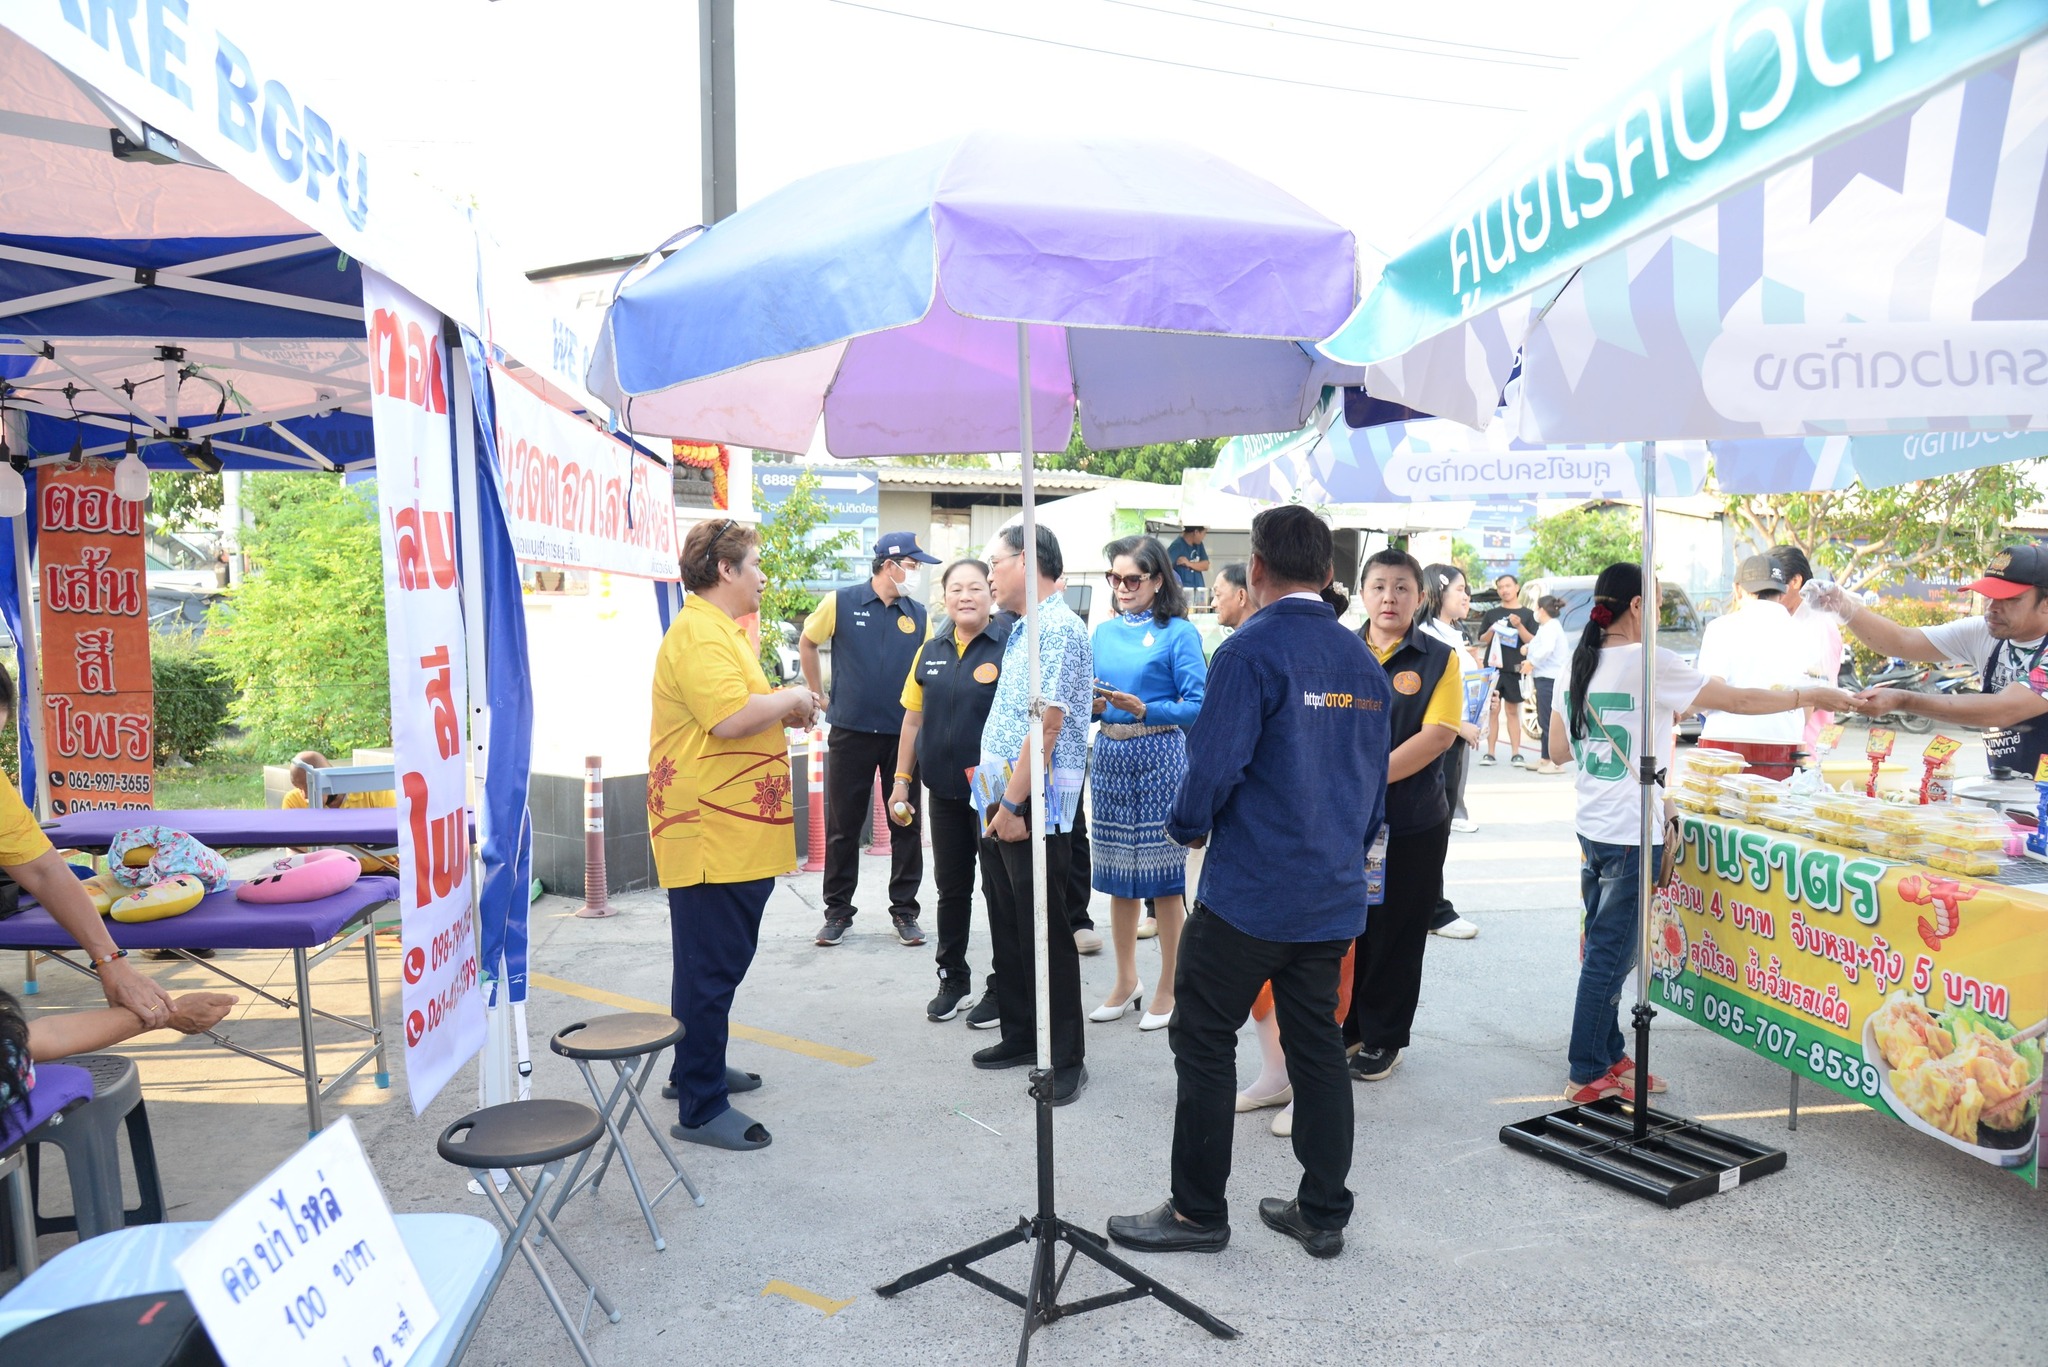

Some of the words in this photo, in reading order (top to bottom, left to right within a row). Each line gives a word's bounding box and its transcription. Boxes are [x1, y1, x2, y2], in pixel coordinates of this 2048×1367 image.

[214, 28, 369, 233] BGPU
[42, 482, 141, 536] ตอก
[46, 546, 142, 615] เส้น
[75, 627, 118, 694] สี
[47, 694, 151, 762] ไพร
[67, 771, 152, 794] 062-997-3655
[401, 770, 469, 909] ไพ
[1689, 928, 1738, 979] สุกี้โรล
[1744, 946, 1851, 1028] น้ำจิ้มรสเด็ด
[1709, 890, 1724, 920] 4
[1729, 900, 1774, 940] บาท
[1789, 910, 1905, 993] จีบหมู+กุ้ง
[1912, 955, 1933, 992] 5
[1942, 970, 2009, 1020] บาท
[1661, 968, 1696, 1012] โทร
[1702, 992, 1880, 1098] 095-707-8539
[284, 1285, 327, 1341] 100
[331, 1238, 377, 1288] บาท
